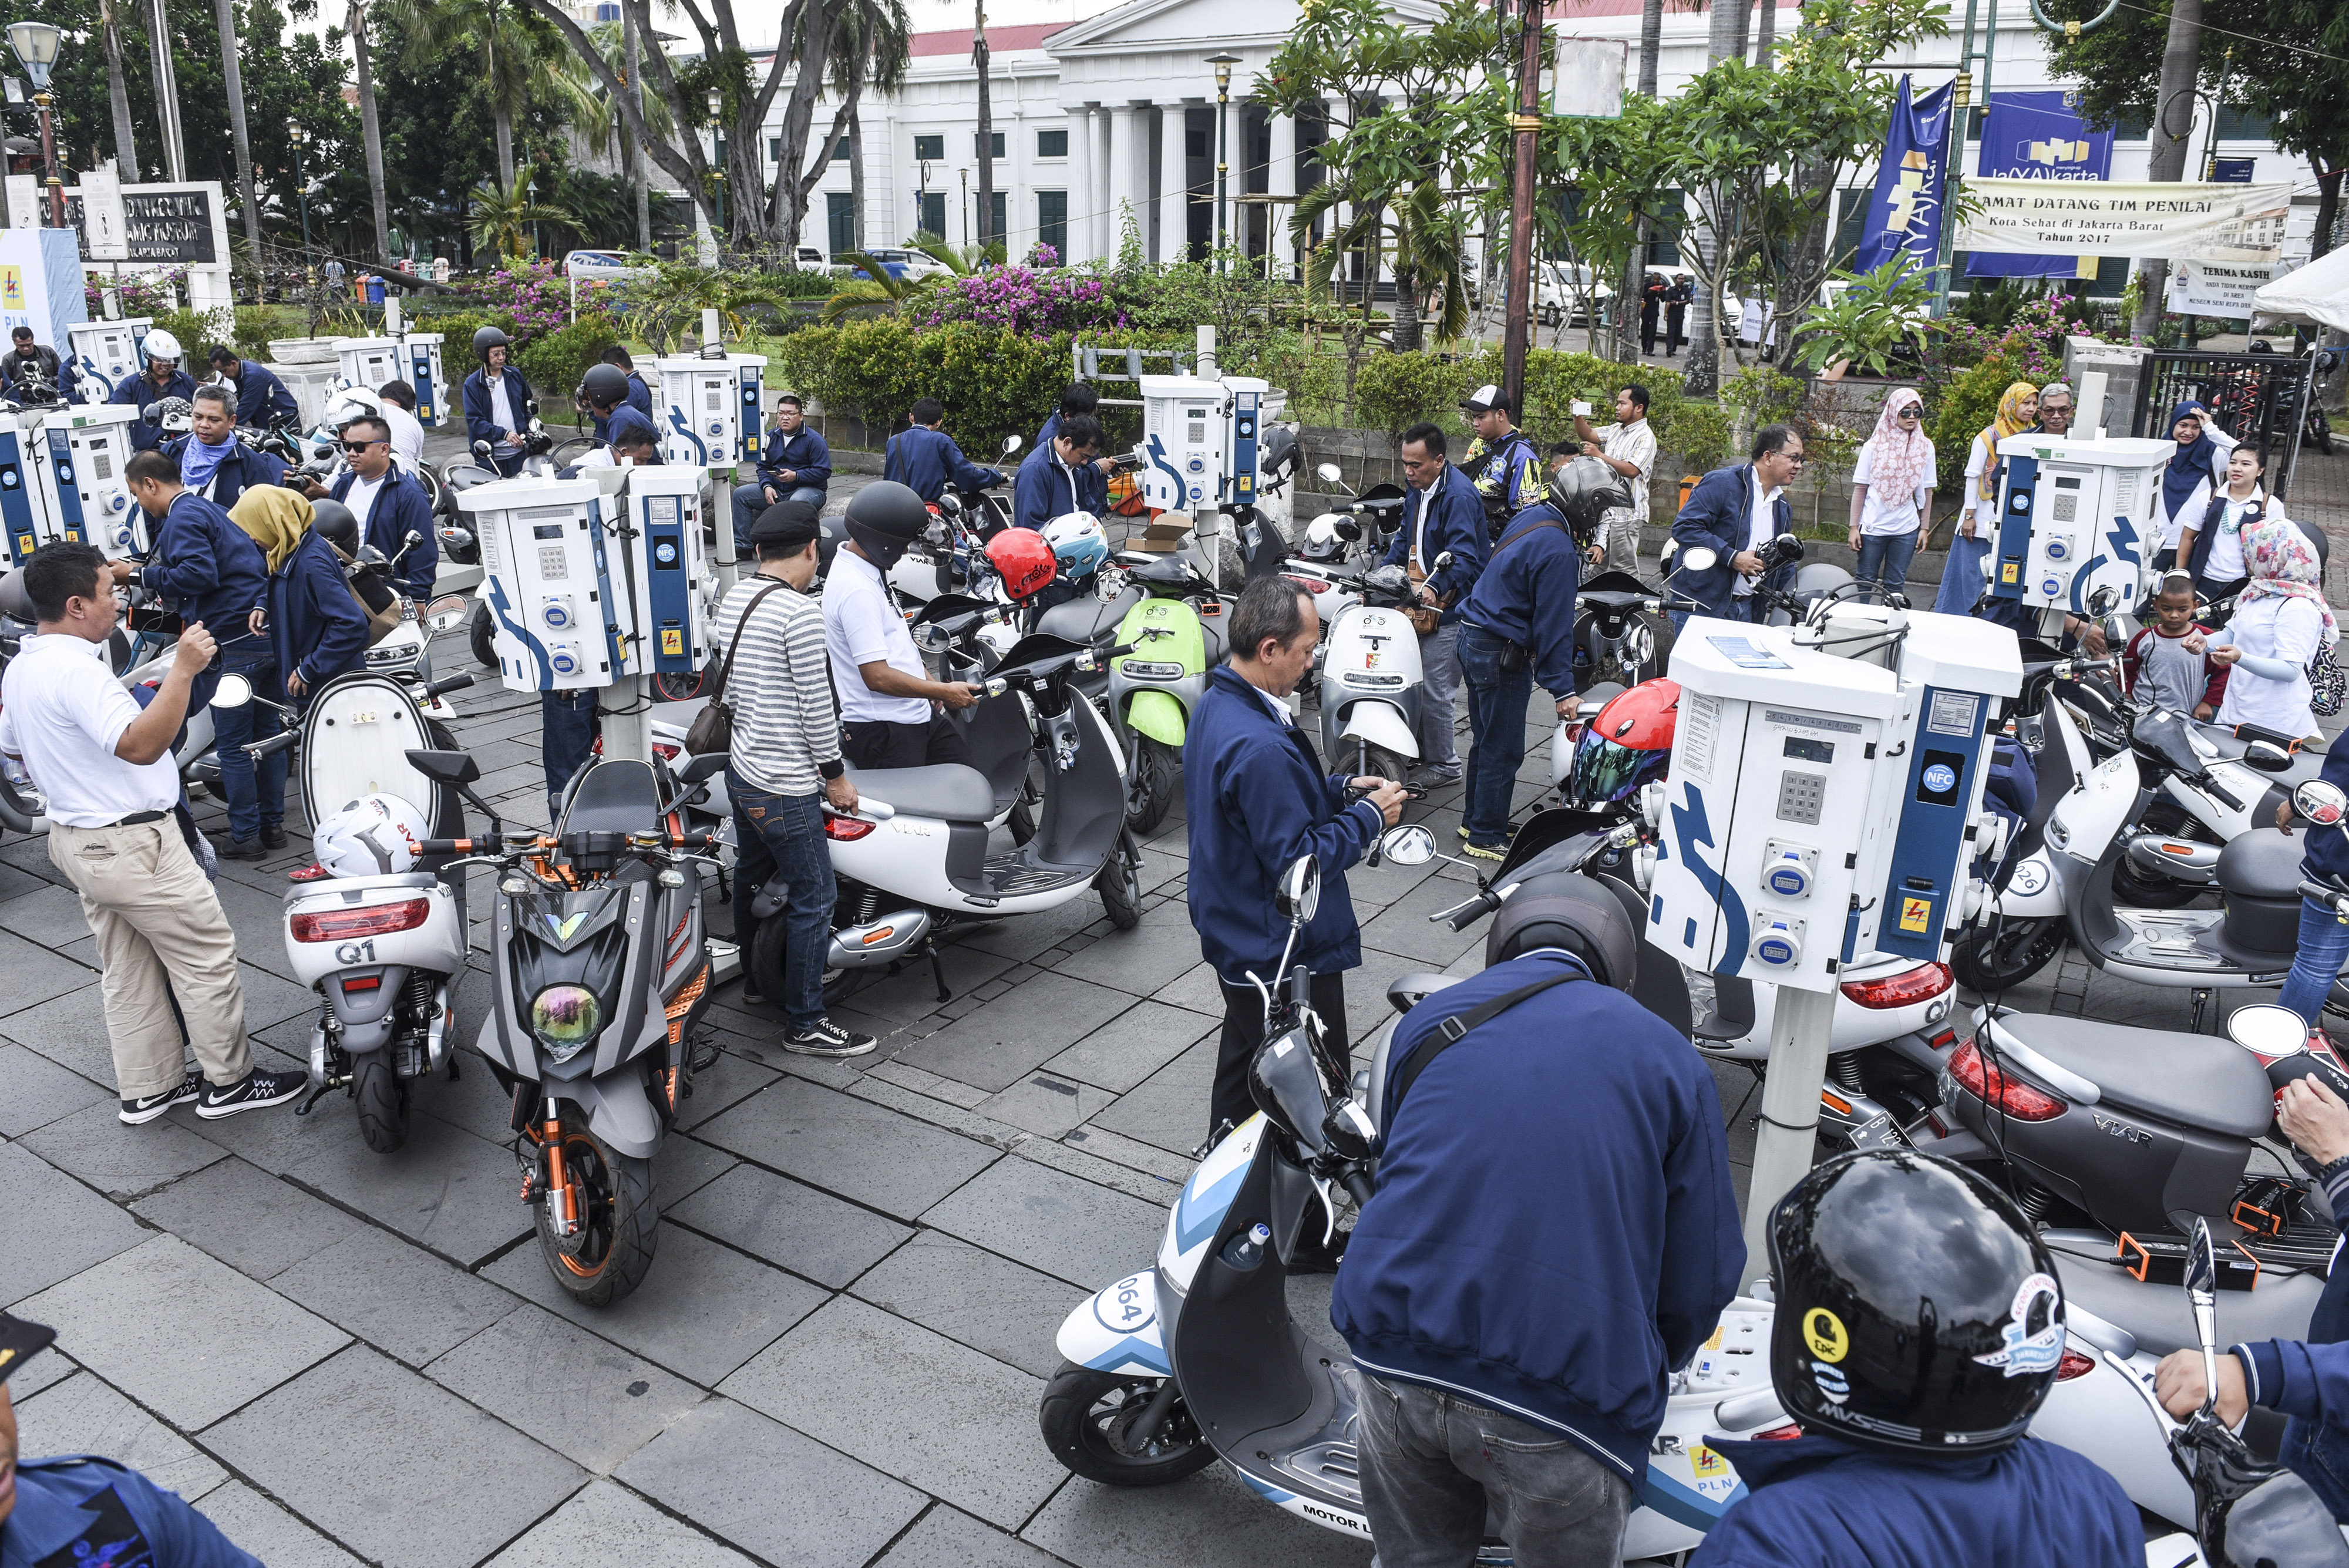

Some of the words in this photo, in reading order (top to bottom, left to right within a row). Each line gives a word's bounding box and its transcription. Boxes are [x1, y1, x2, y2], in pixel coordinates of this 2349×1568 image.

[2034, 198, 2099, 210] DATANG
[2109, 200, 2136, 211] TIM
[2145, 201, 2212, 213] PENILAI
[154, 221, 200, 241] MUSEUM
[1990, 217, 2017, 227] Kota
[2022, 218, 2056, 227] Sehat
[2062, 219, 2072, 228] di
[2078, 219, 2123, 230] Jakarta
[2129, 221, 2163, 231] Barat
[2037, 232, 2072, 242] Tahun
[2079, 234, 2111, 243] 2017
[2203, 267, 2237, 277] TERIMA
[2240, 270, 2270, 279] KASIH
[5, 316, 28, 329] PLN
[910, 556, 928, 565] VIAR
[1927, 772, 1953, 785] NFC
[370, 800, 383, 816] VIAR
[723, 820, 732, 831] B
[891, 822, 930, 836] VIAR
[2015, 866, 2038, 889] 026
[335, 938, 376, 965] Q1
[1925, 993, 1951, 1024] Q1
[1870, 1116, 1886, 1128] B
[2092, 1113, 2153, 1149] VIAR
[1118, 1277, 1142, 1321] 064
[1138, 1436, 1150, 1451] VIAR
[1698, 1479, 1732, 1492] PLN
[1303, 1504, 1358, 1530] MOTOR
